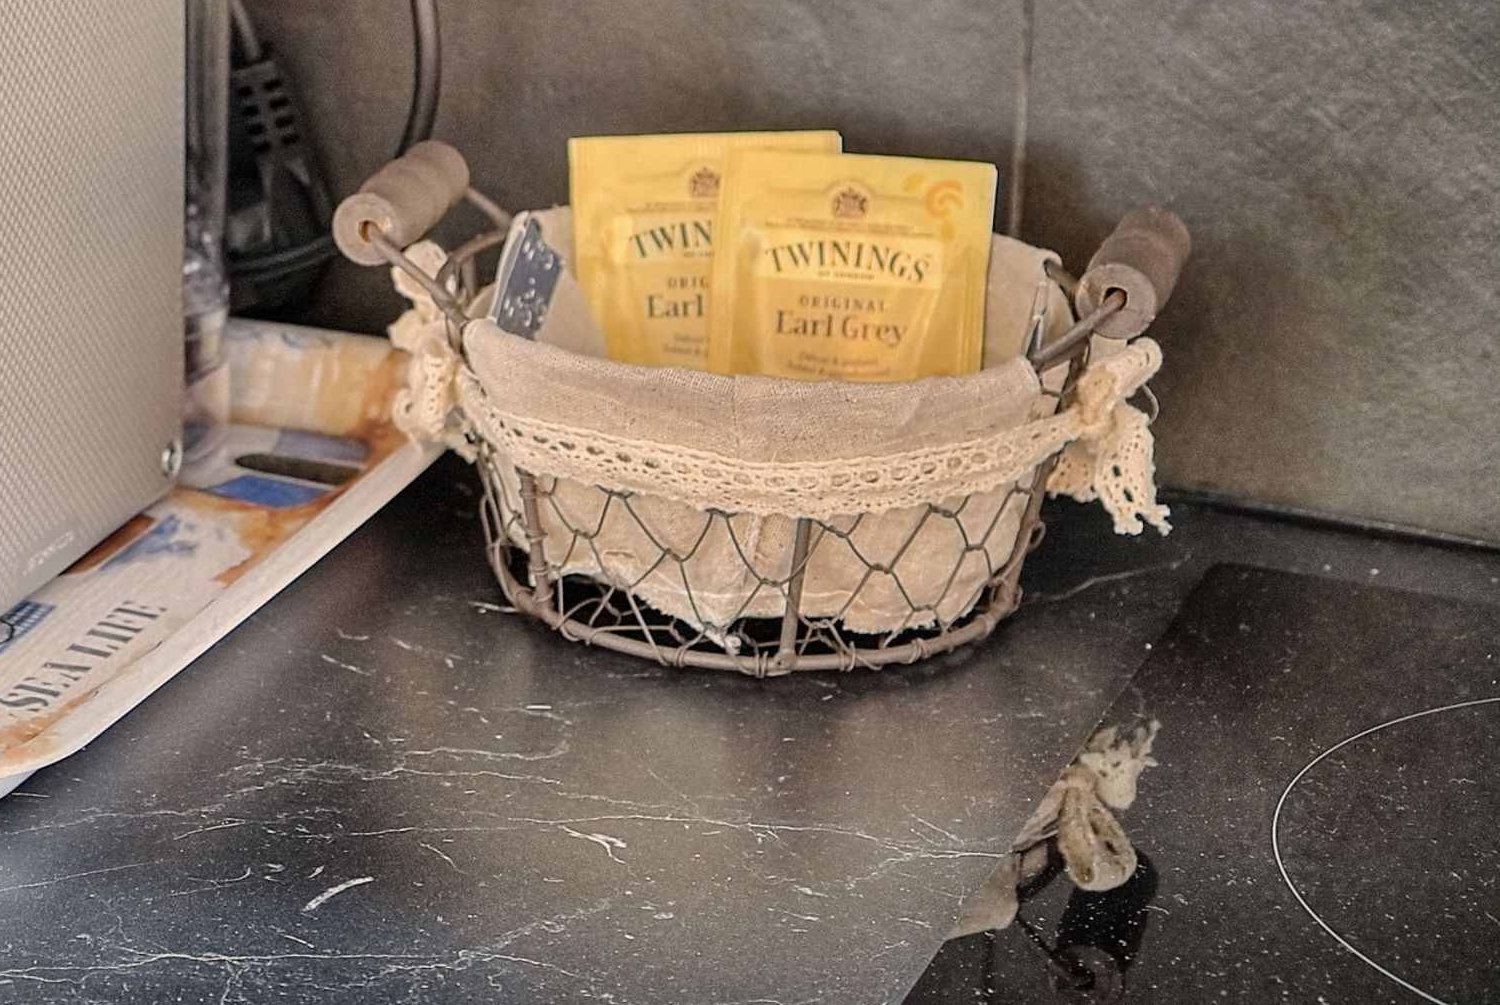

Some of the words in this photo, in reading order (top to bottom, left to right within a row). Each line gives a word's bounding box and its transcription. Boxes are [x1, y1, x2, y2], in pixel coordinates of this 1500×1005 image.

[629, 220, 713, 258] TWIN
[765, 241, 932, 283] TWININGS
[667, 276, 710, 289] ORIG
[647, 295, 704, 318] Earl
[799, 294, 888, 312] ORIGINAL
[776, 309, 834, 338] Earl
[841, 314, 908, 349] Grey
[0, 661, 92, 715] SEA
[66, 601, 167, 659] LIFE
